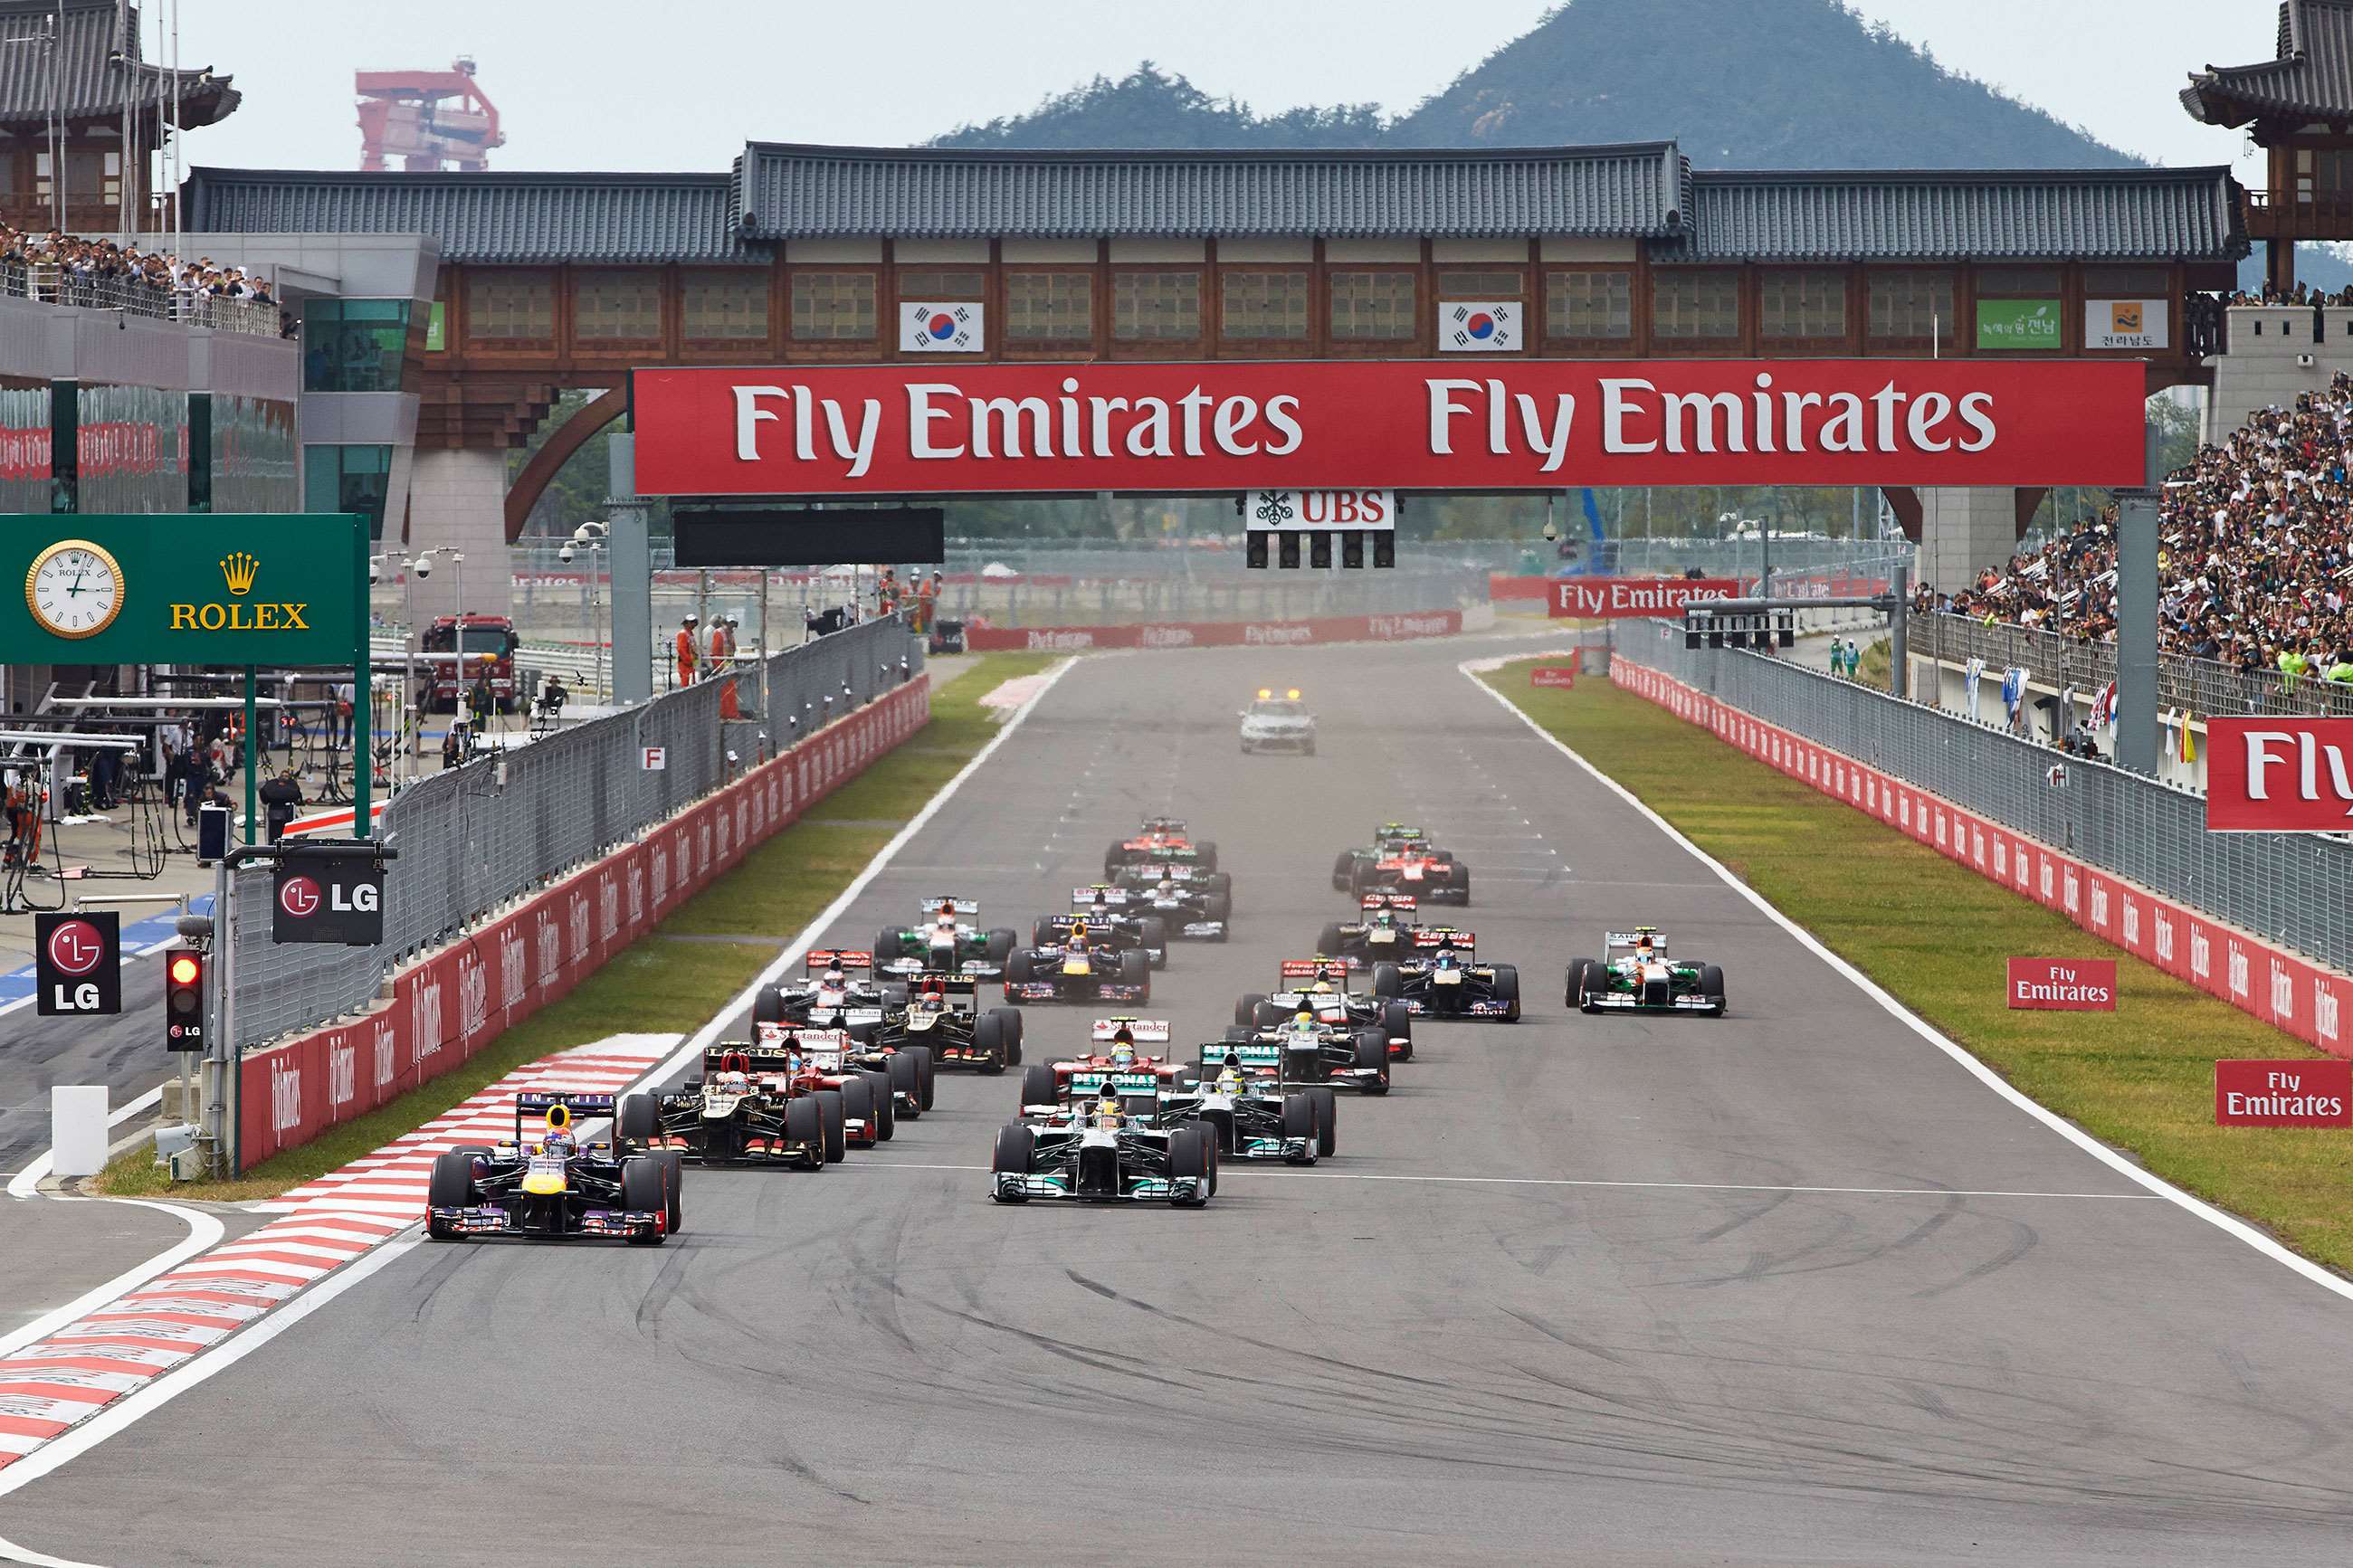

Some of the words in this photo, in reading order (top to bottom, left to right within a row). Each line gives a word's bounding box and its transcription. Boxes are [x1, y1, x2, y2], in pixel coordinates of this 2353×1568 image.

[2101, 336, 2153, 347] 전라남도
[731, 385, 881, 478] Fly
[904, 377, 1303, 459] Emirates
[1424, 378, 1576, 471] Fly
[1598, 372, 1996, 453] Emirates
[1300, 489, 1385, 523] UBS
[59, 569, 91, 577] ROLEX
[1559, 584, 1605, 614] Fly
[169, 603, 310, 631] ROLEX
[646, 748, 662, 768] F
[331, 883, 378, 912] LG
[2049, 965, 2076, 984] Fly
[53, 983, 100, 1011] LG
[2015, 980, 2110, 1003] Emirates
[185, 1026, 201, 1036] LG
[780, 1031, 838, 1041] Sntander
[1110, 1021, 1167, 1032] Satander
[2267, 1071, 2301, 1092] Fly
[2226, 1091, 2343, 1117] Emirates
